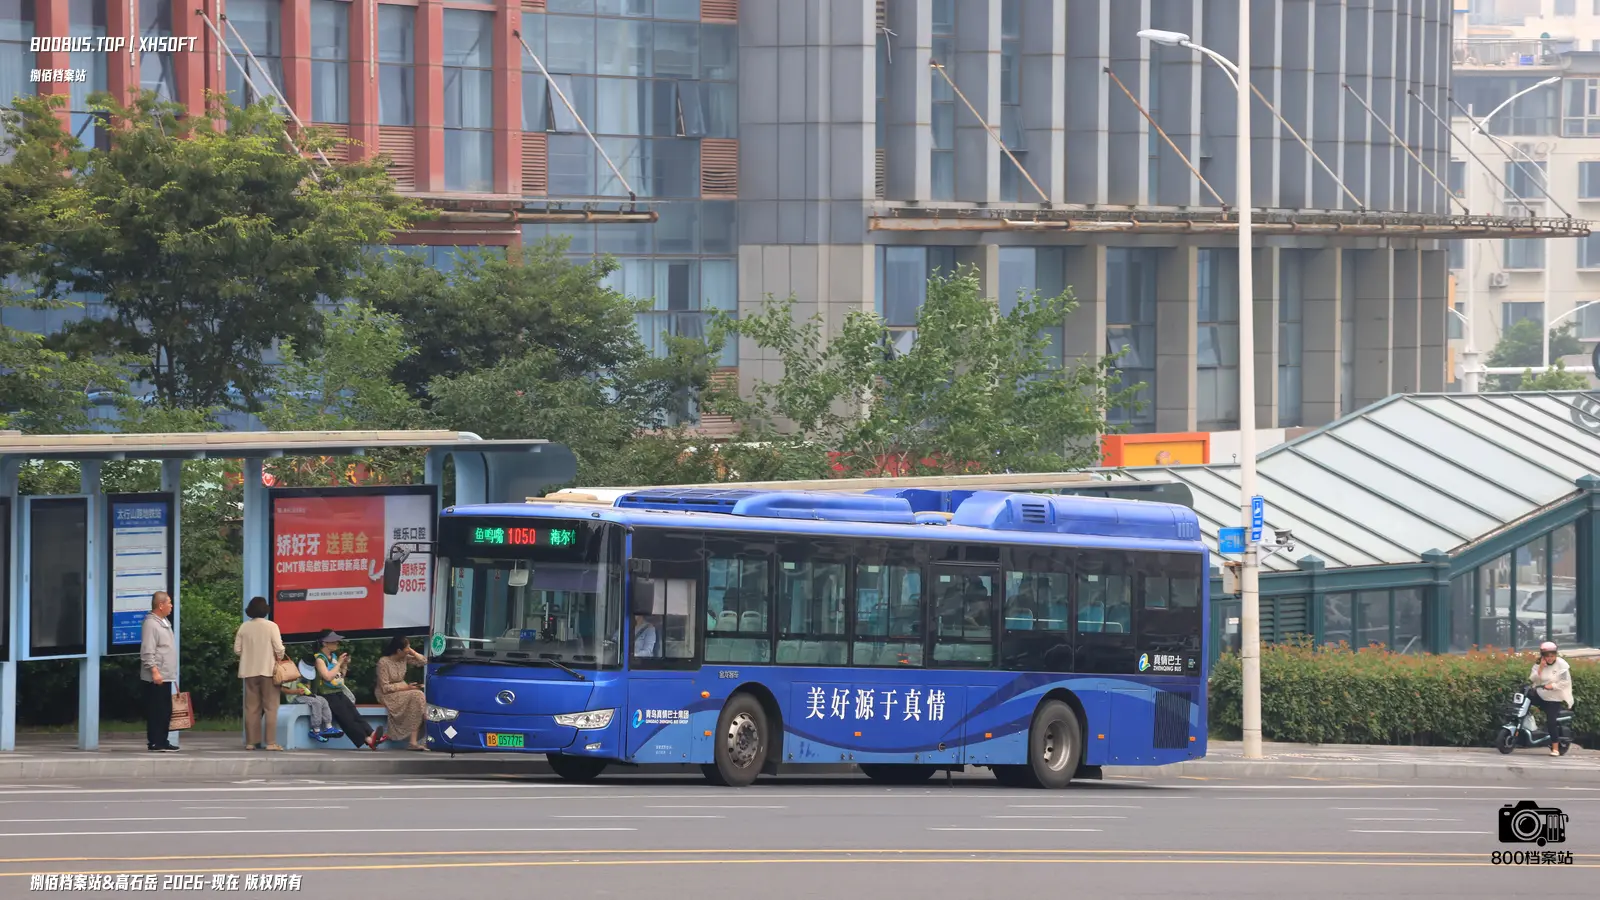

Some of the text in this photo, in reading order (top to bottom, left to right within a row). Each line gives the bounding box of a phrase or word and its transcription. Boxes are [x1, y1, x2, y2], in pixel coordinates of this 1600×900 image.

[276, 533, 321, 557] 矫好牙
[326, 531, 369, 555] 送黄金
[507, 527, 536, 545] 1050
[400, 578, 426, 592] 980元
[1153, 654, 1182, 666] 真情巴士
[805, 686, 946, 722] 美好源于真情
[646, 709, 689, 719] 青岛真情巴士集团
